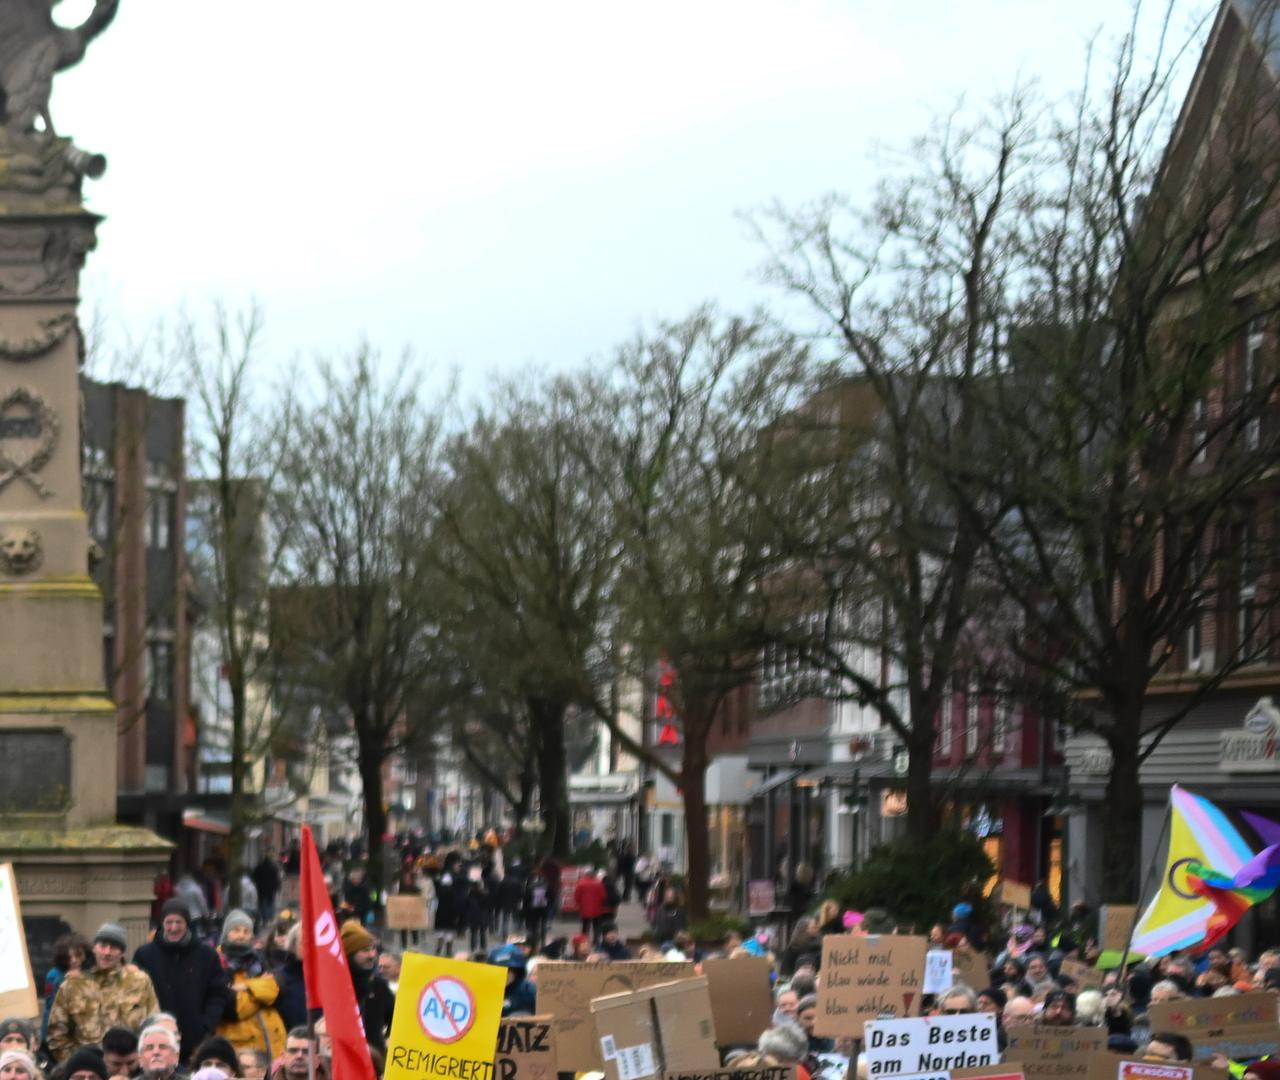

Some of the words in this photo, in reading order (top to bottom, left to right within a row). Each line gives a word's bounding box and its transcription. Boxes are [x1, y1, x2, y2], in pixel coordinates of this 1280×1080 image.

[829, 950, 859, 966] Nicht
[869, 950, 891, 966] mal
[424, 997, 468, 1022] AfD
[872, 1031, 910, 1048] Das
[929, 1026, 990, 1045] Beste
[871, 1059, 901, 1074] am
[919, 1053, 990, 1071] Norden
[1131, 1066, 1183, 1078] MENSCHEN
